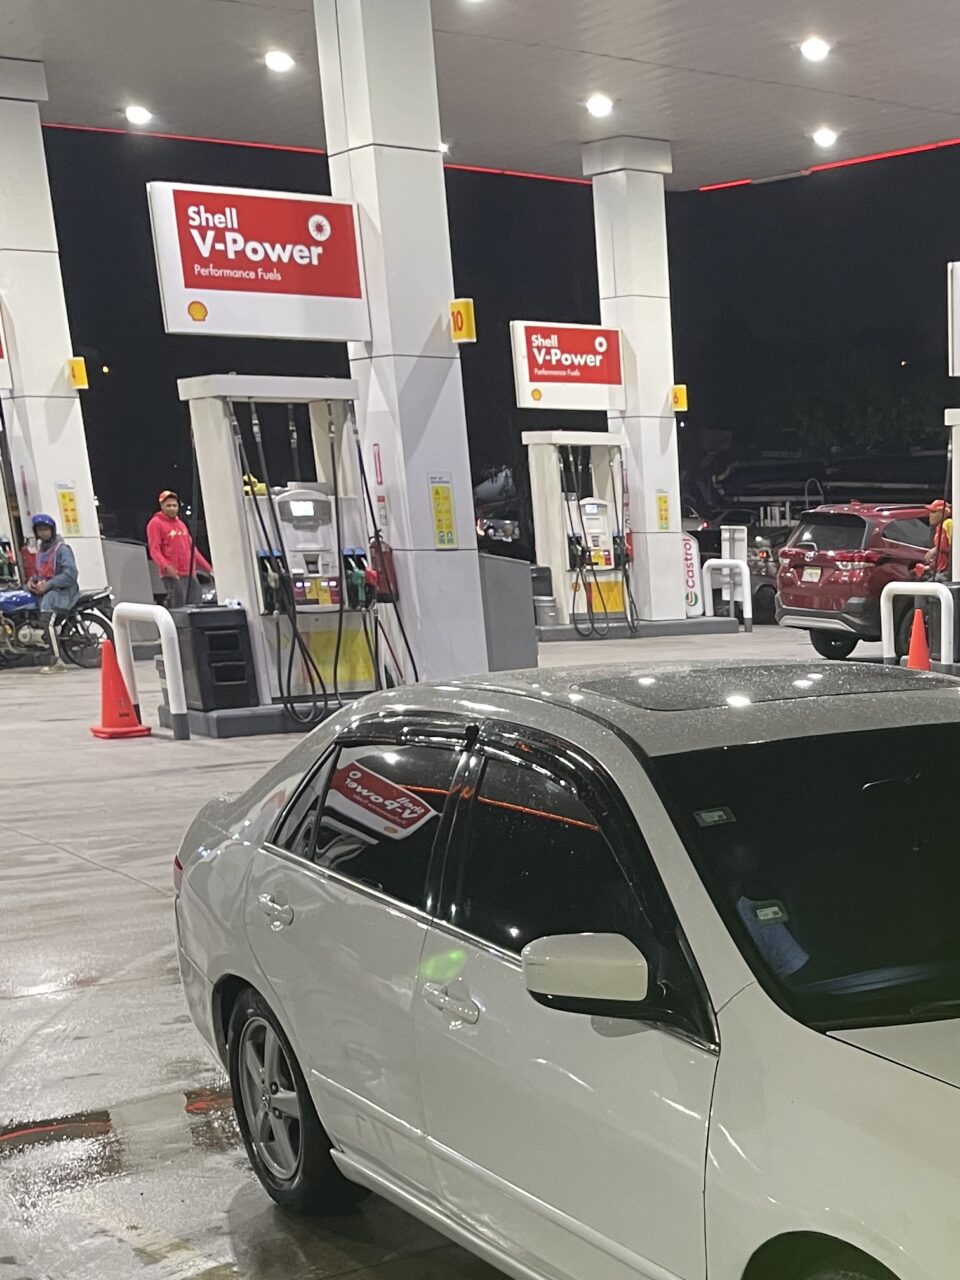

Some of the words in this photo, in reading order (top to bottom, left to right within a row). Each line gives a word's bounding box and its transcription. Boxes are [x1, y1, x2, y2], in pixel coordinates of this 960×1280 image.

[187, 205, 238, 229] Shell
[190, 229, 323, 265] V-Power
[194, 264, 255, 280] Performance
[258, 269, 281, 281] Fuels
[451, 310, 463, 331] 10
[531, 334, 558, 347] Shell
[533, 348, 603, 366] V-Power
[682, 538, 695, 588] Castrol
